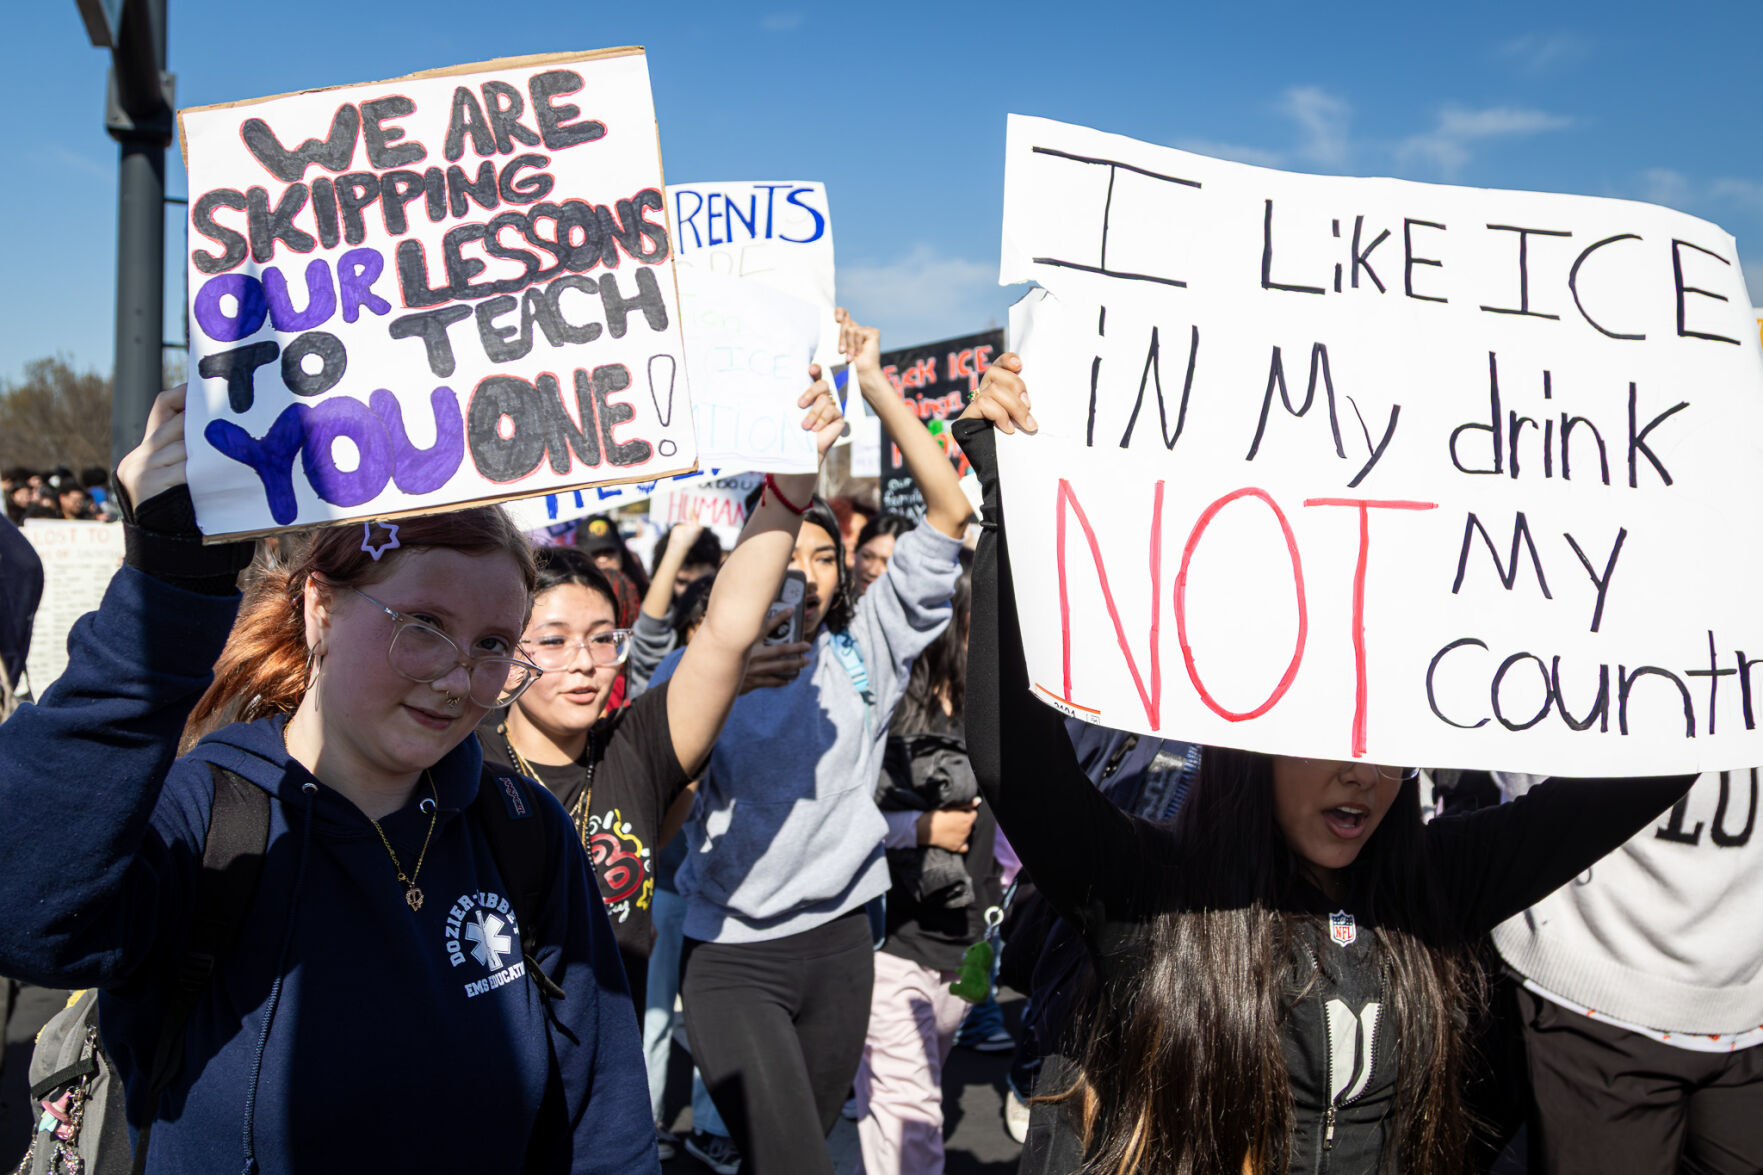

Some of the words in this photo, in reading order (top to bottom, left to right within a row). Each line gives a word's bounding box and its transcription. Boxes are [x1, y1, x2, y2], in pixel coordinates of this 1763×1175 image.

[240, 95, 427, 182] WE
[444, 69, 608, 162] ARE
[191, 154, 554, 275] SKIPPING
[194, 247, 391, 342] OUR
[396, 187, 672, 308] LESSONS
[676, 185, 825, 255] RENTS
[1032, 146, 1201, 288] I
[1480, 223, 1741, 346] ICE
[198, 331, 347, 413] TO
[389, 267, 669, 377] TEACH
[713, 346, 792, 380] ICE
[948, 345, 993, 379] ICE
[203, 386, 464, 525] YOU
[693, 402, 814, 453] TION
[1449, 351, 1690, 488] drink
[1056, 477, 1439, 759] NOT
[464, 979, 490, 998] EMS
[1335, 926, 1354, 940] NFL
